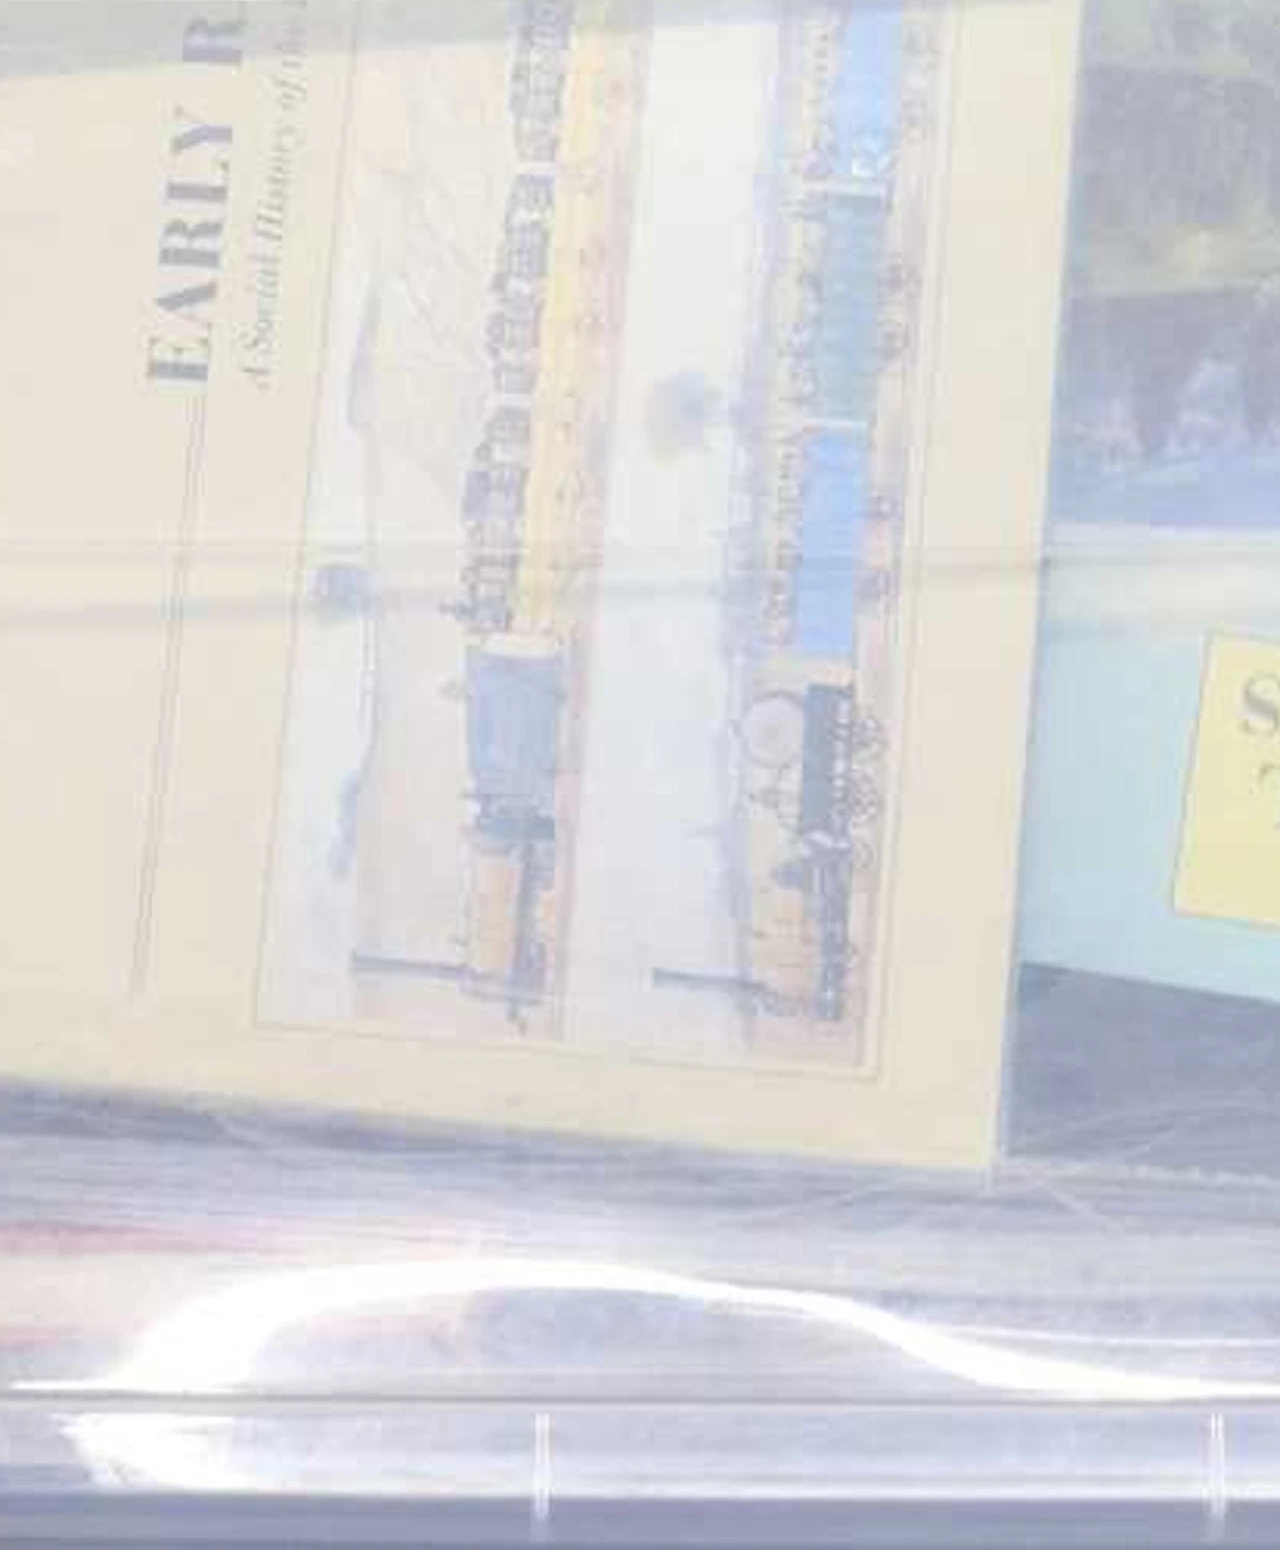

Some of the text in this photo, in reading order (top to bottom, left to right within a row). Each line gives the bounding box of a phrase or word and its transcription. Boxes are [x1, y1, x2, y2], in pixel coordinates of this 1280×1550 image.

[144, 104, 236, 384] EARLY
[250, 118, 298, 244] History
[241, 250, 288, 358] Social
